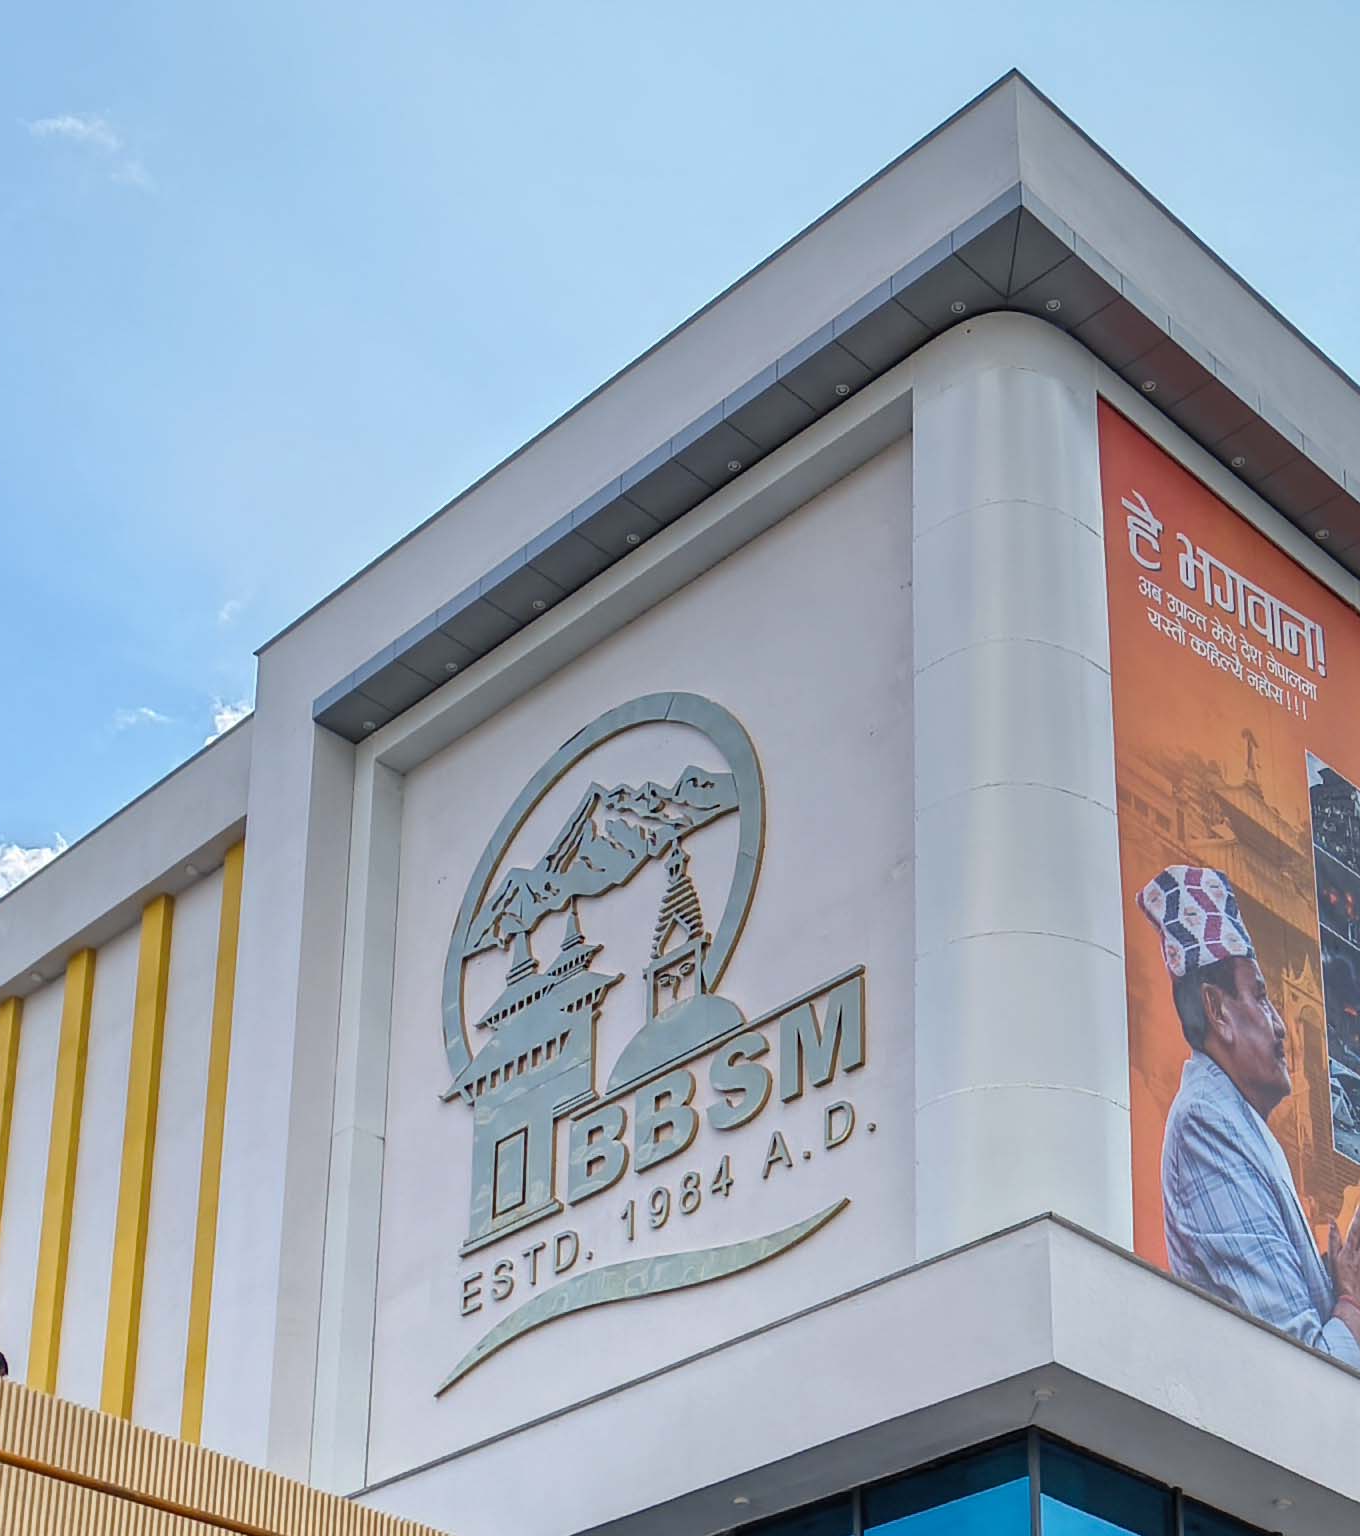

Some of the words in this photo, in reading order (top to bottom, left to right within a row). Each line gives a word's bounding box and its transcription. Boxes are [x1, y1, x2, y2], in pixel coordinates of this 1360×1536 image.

[1121, 488, 1164, 571] हे
[1176, 532, 1328, 678] भगवान!
[1138, 575, 1163, 605] अब
[1210, 616, 1237, 652] मेरो
[1239, 633, 1263, 669] देश
[1265, 651, 1318, 701] नेपालमा
[1146, 606, 1187, 646] यस्तो
[567, 973, 867, 1207] BBSM
[458, 1229, 594, 1318] ESTD.
[619, 1154, 735, 1242] 1984
